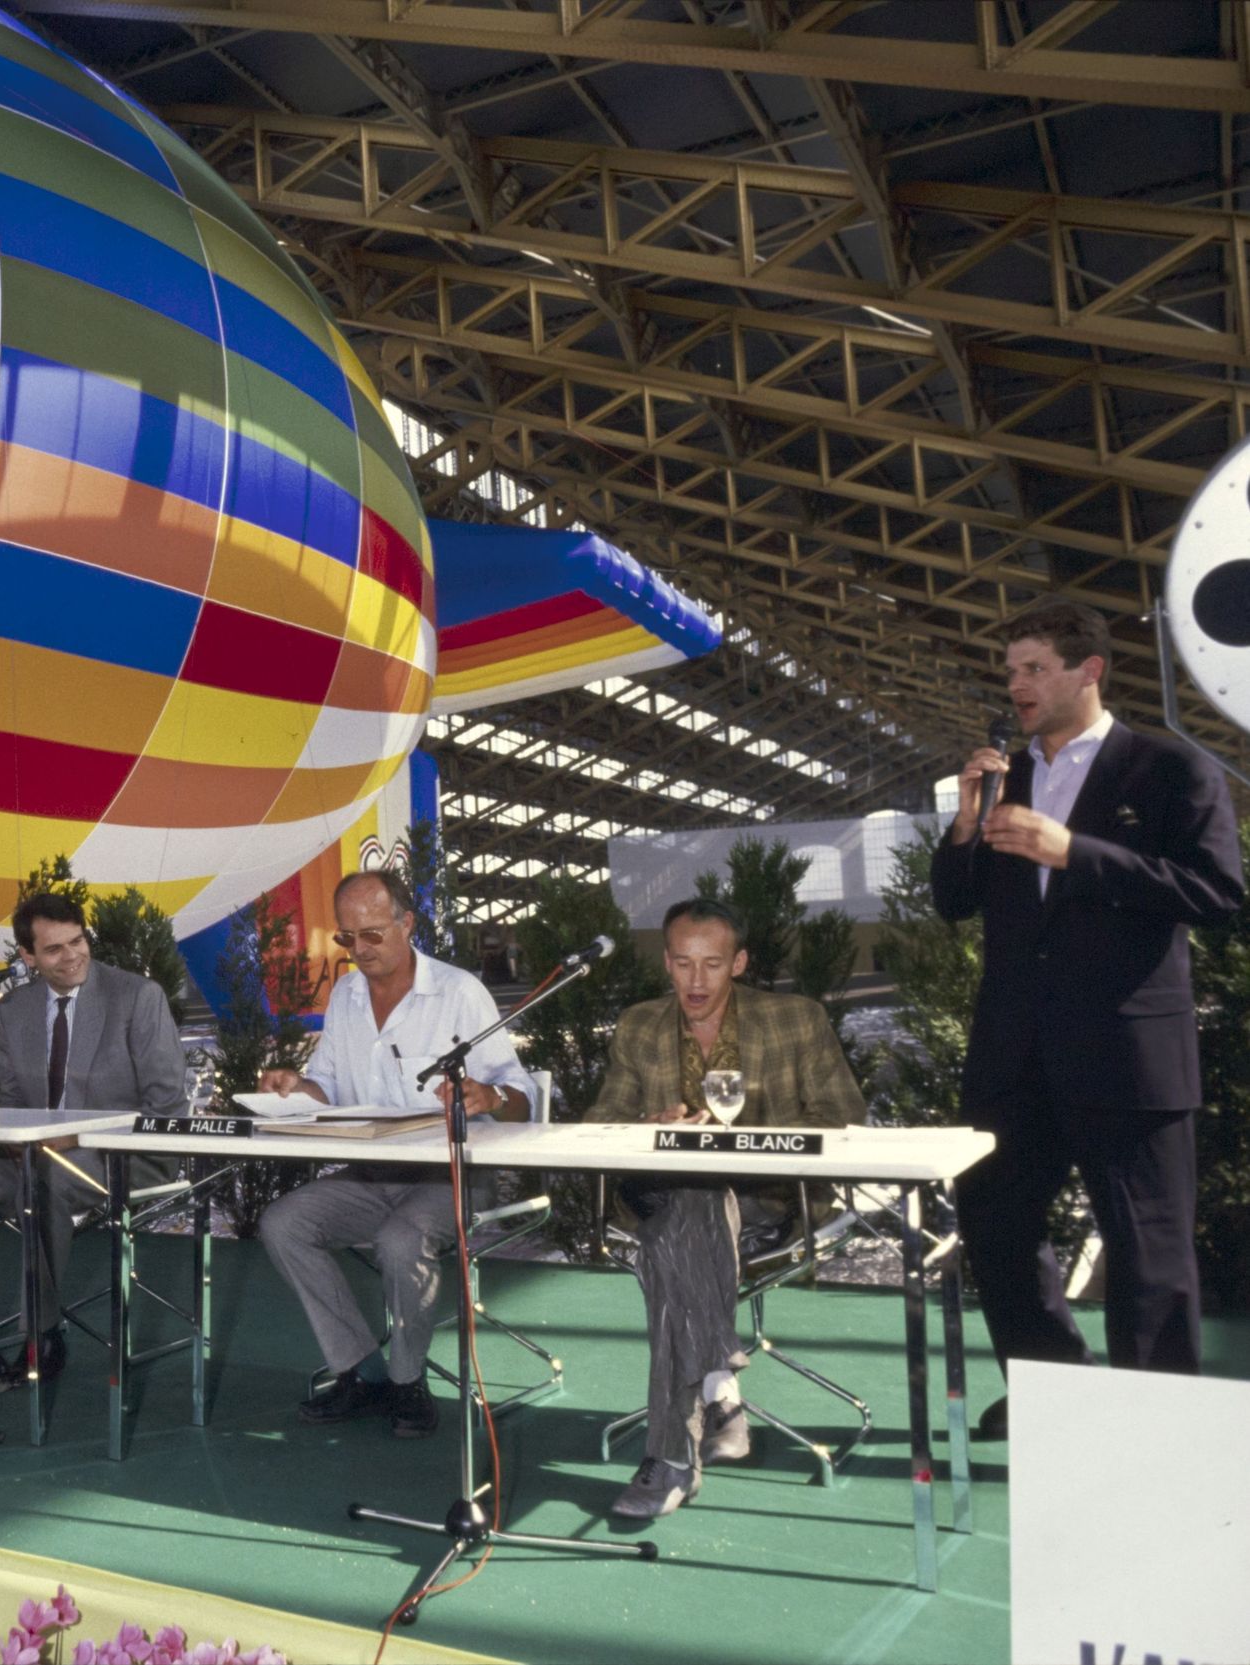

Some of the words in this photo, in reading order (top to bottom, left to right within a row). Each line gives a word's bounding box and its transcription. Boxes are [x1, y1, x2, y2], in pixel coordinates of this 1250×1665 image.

[142, 1118, 157, 1131] M.
[167, 1119, 180, 1132] F.
[189, 1120, 237, 1134] HALLE
[659, 1132, 680, 1147] M.
[700, 1133, 718, 1148] P.
[735, 1134, 805, 1151] BLANC
